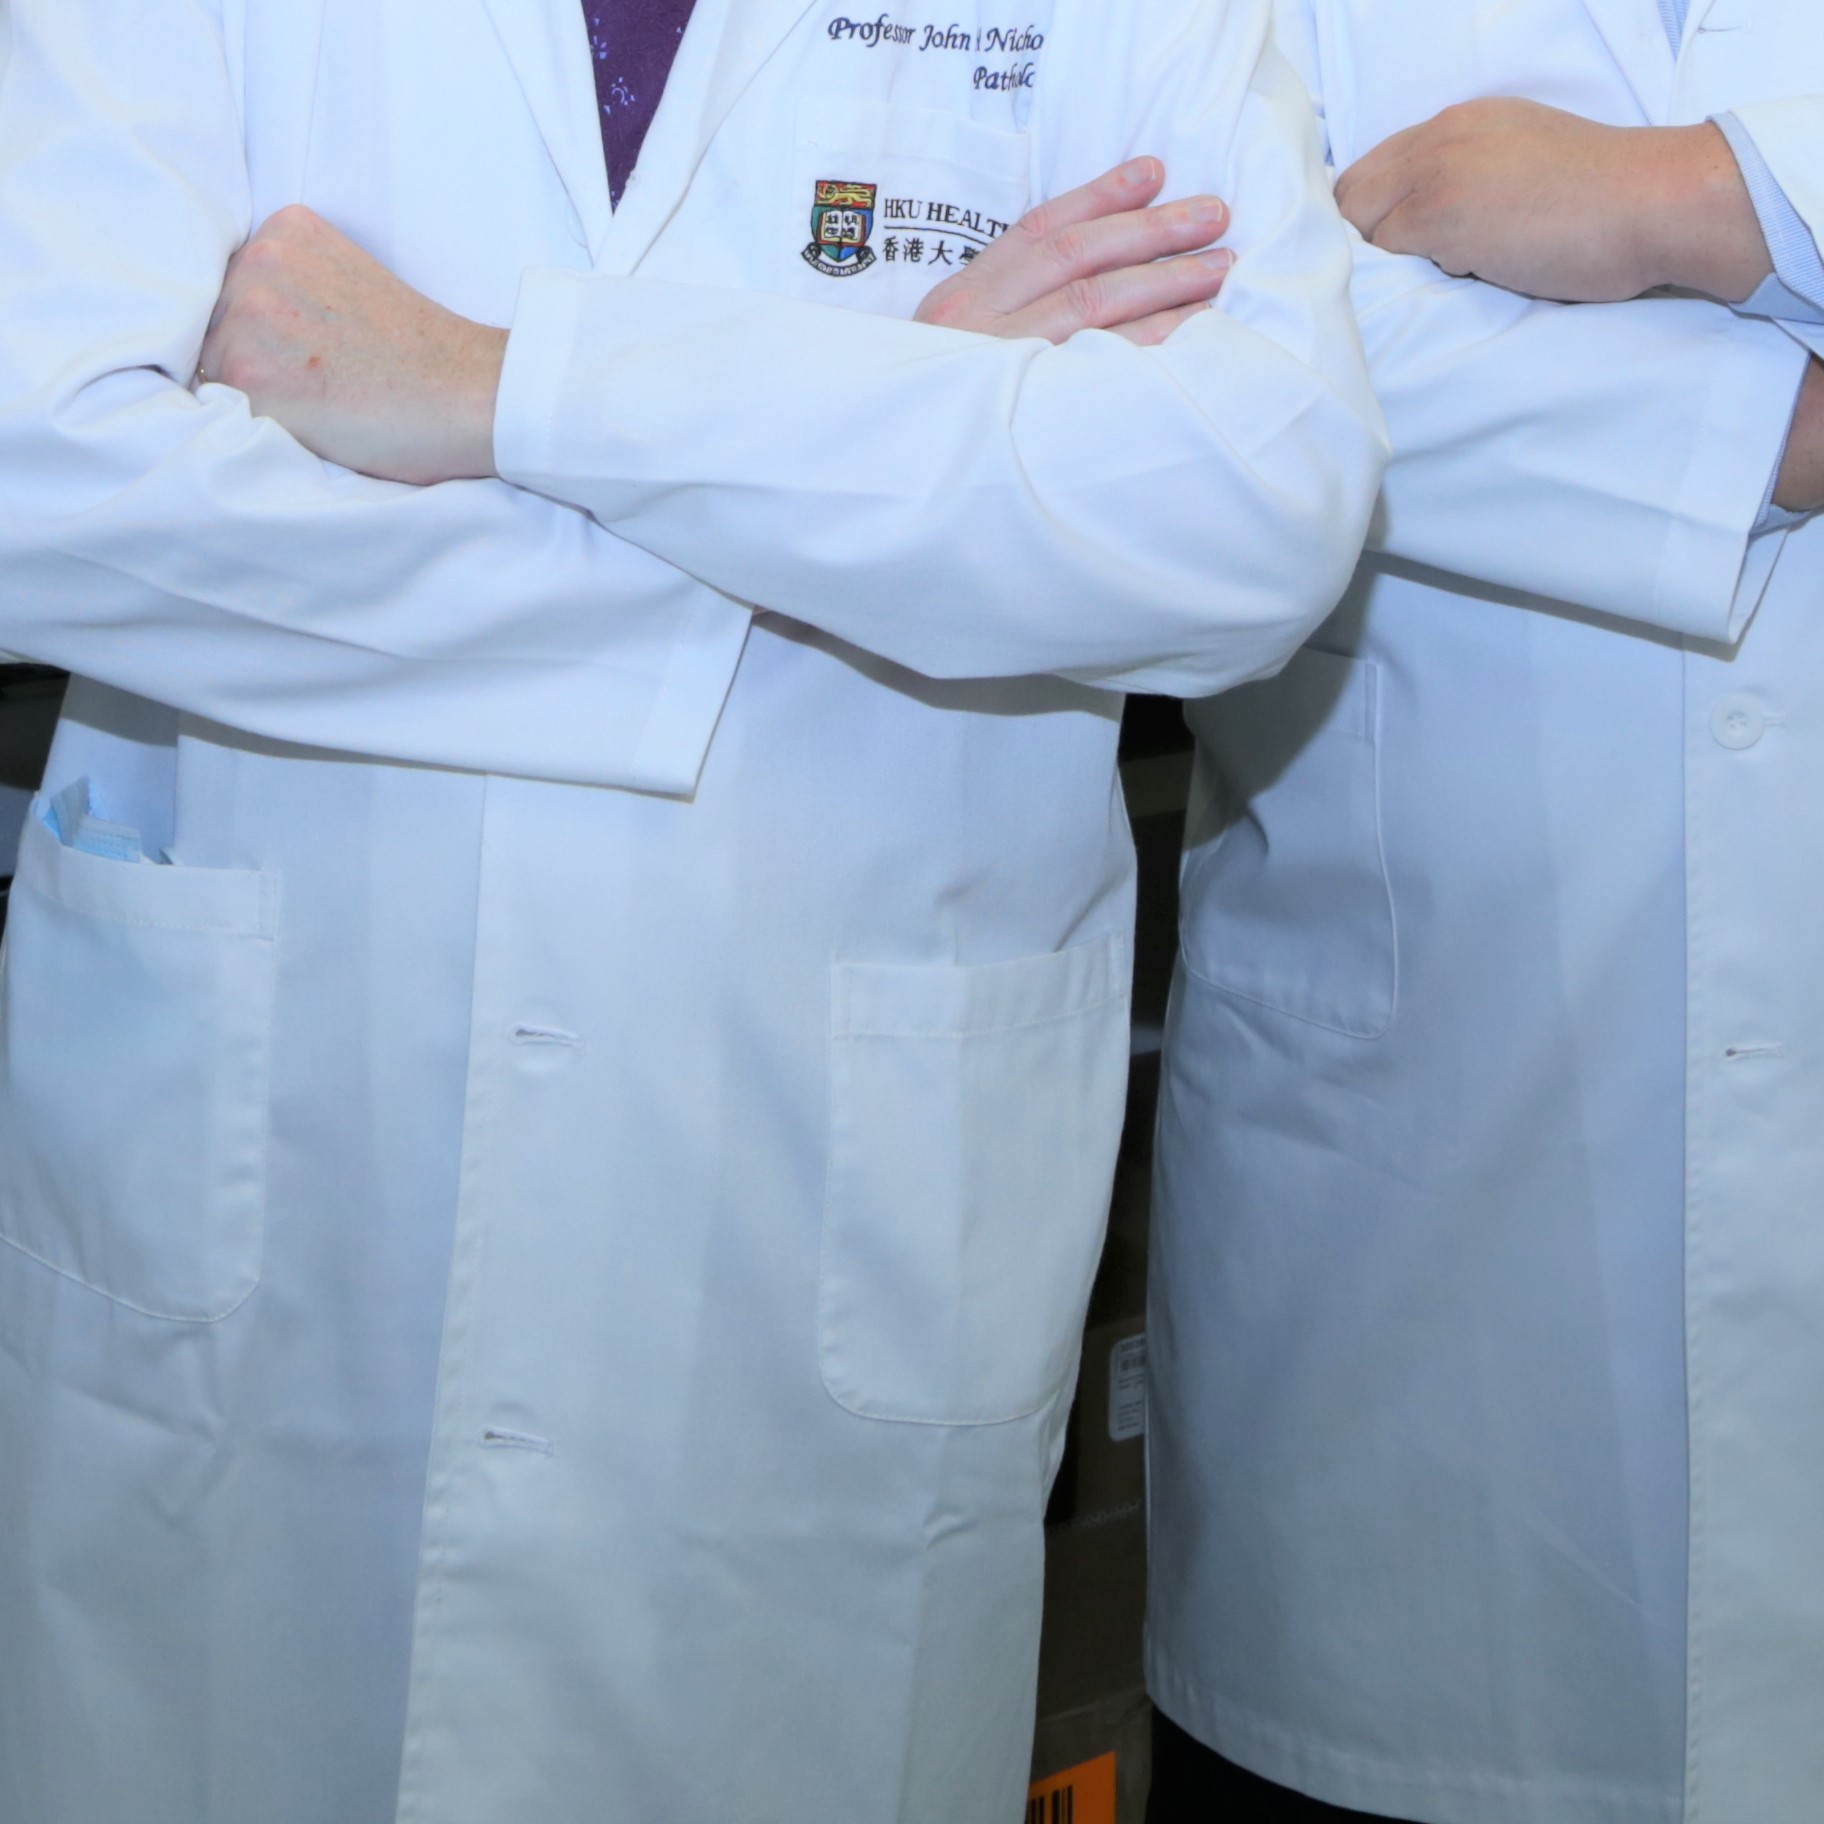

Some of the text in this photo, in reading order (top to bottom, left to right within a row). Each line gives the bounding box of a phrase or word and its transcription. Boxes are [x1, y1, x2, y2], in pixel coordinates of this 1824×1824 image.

[827, 13, 916, 48] Professor
[919, 23, 971, 52] John
[883, 198, 923, 219] HKU
